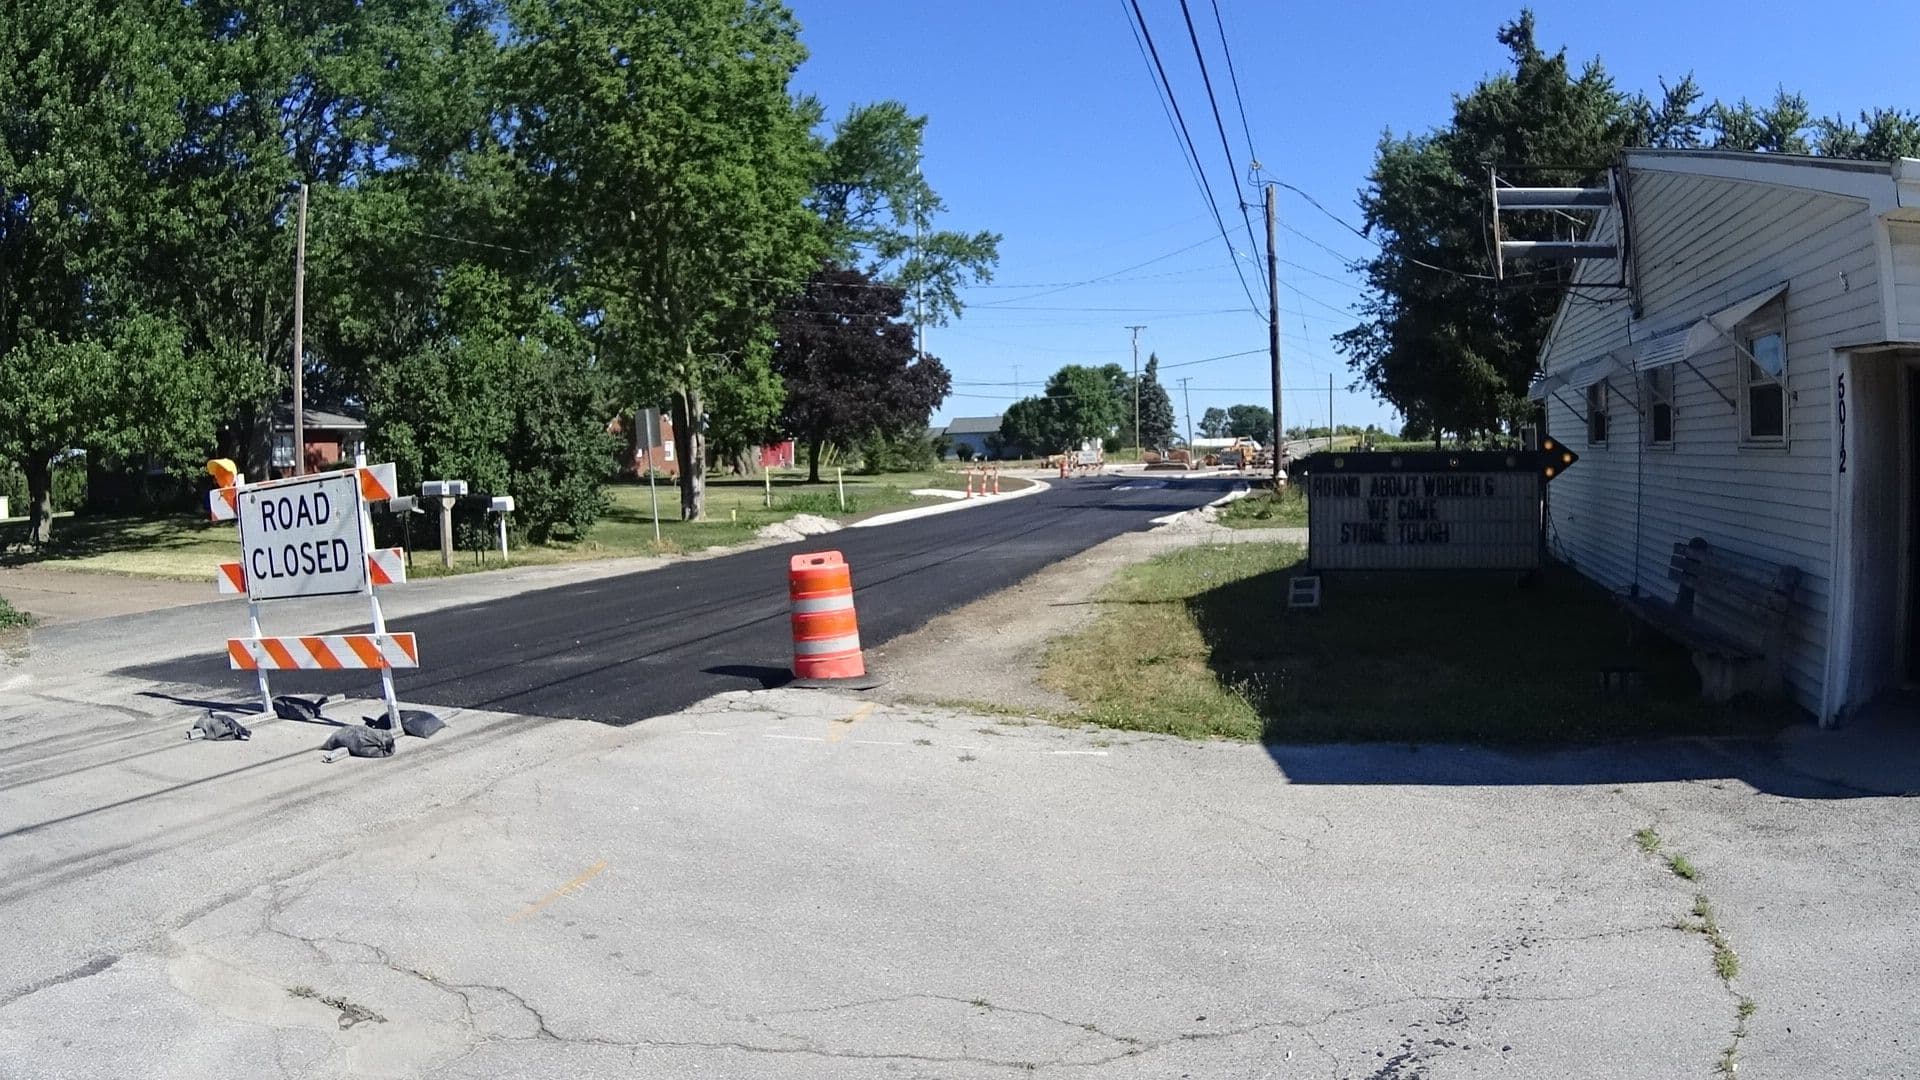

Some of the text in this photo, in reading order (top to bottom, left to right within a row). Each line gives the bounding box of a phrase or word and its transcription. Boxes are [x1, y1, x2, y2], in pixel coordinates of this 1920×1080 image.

[1838, 373, 1847, 473] 5012
[1313, 476, 1361, 497] ROUND
[1370, 476, 1418, 497] ABOUT
[261, 492, 330, 532] ROAD
[1341, 522, 1386, 544] STONE
[252, 539, 349, 579] CLOSED
